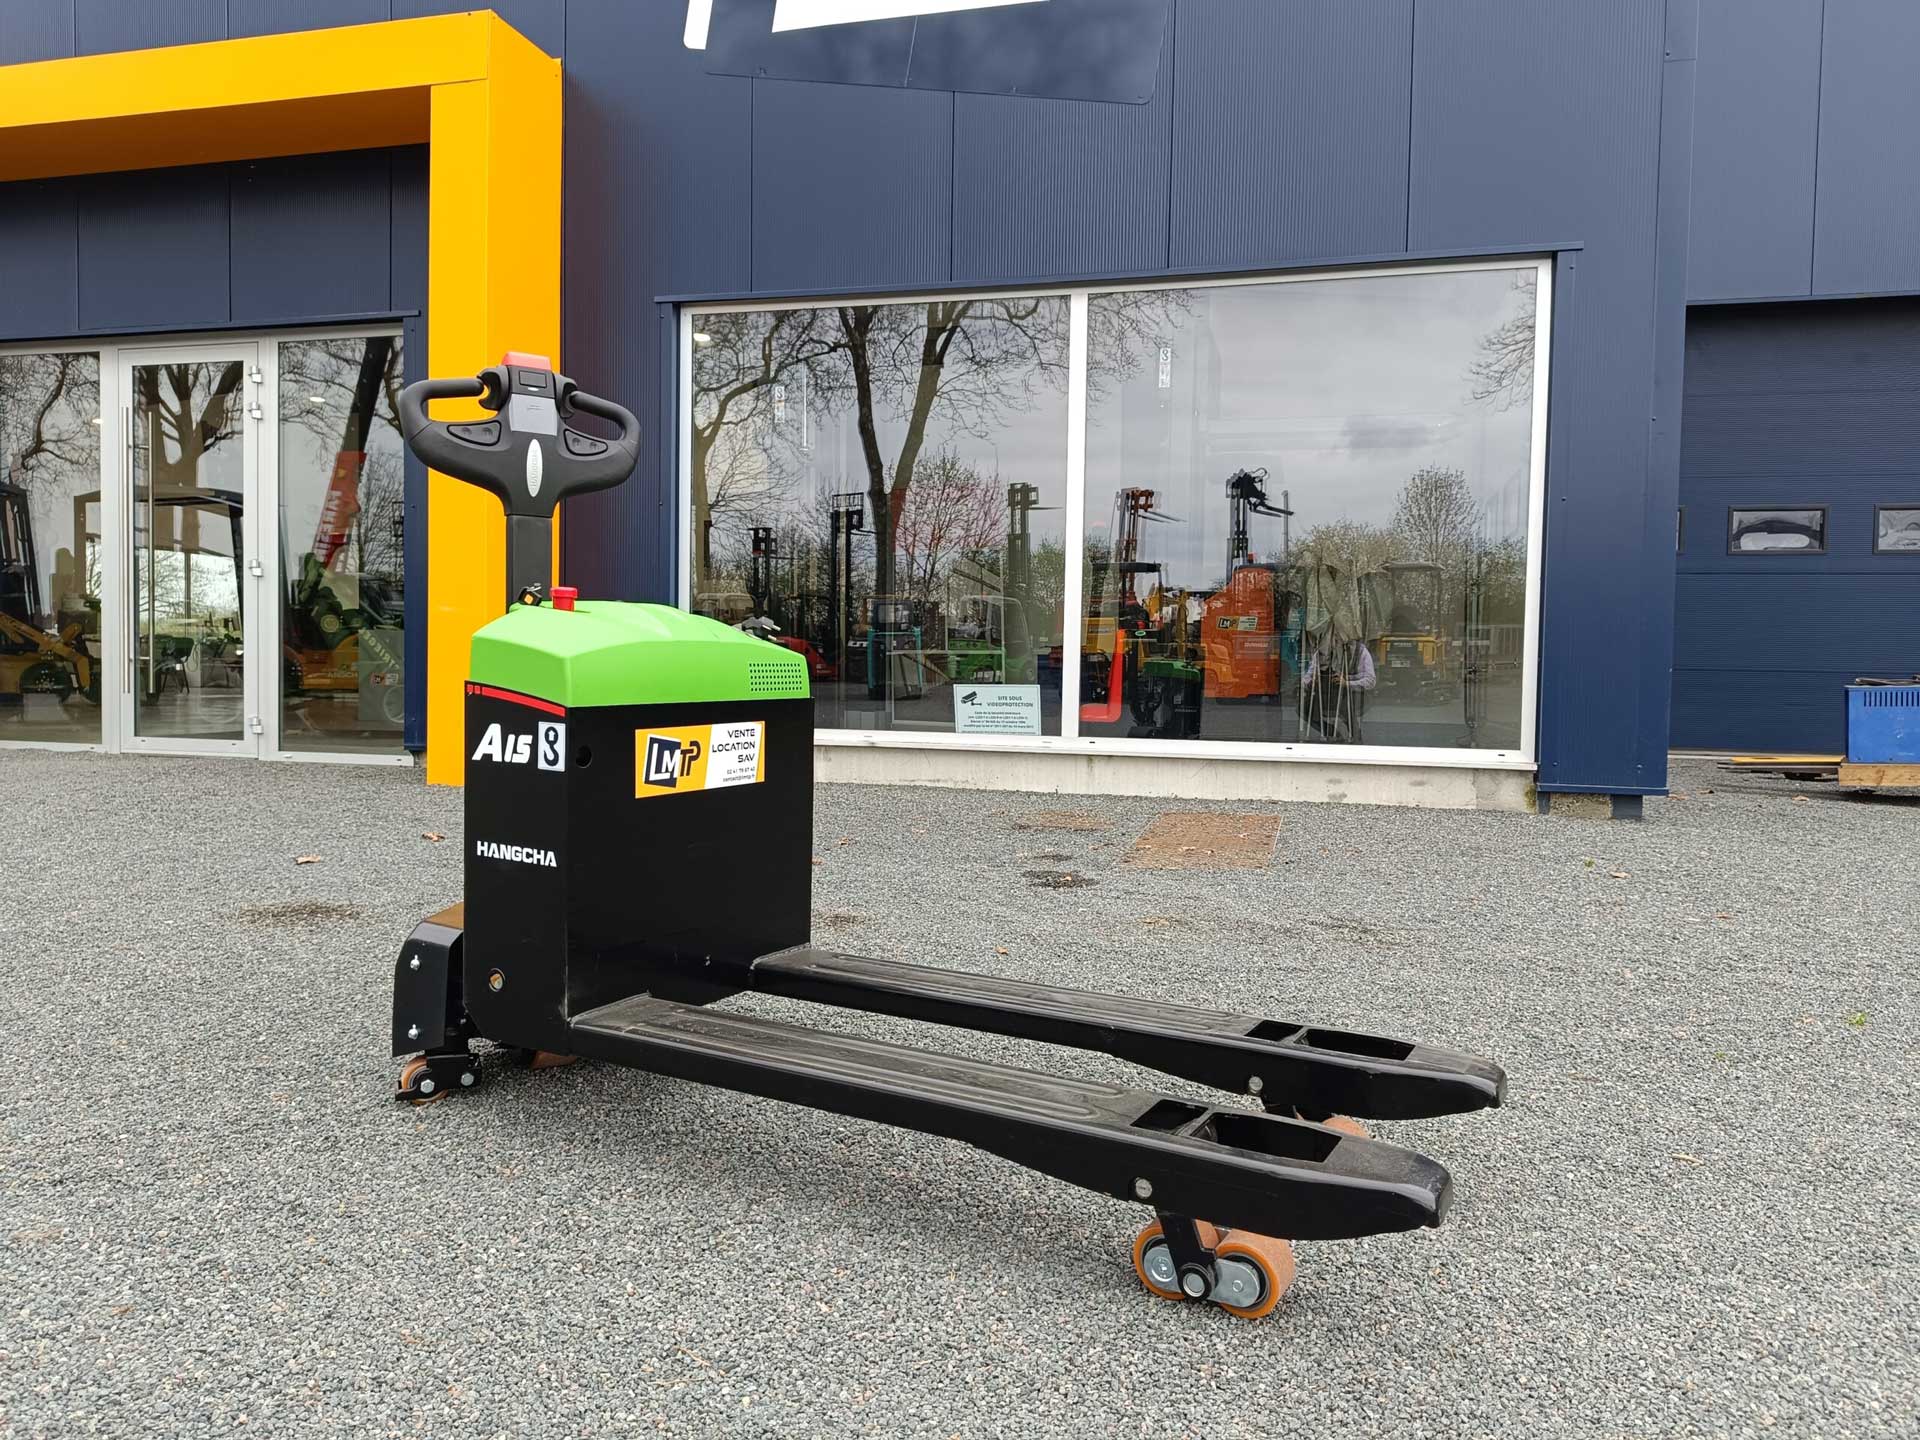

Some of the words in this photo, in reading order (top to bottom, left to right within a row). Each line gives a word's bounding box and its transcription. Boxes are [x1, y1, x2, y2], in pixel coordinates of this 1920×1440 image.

[728, 728, 755, 738] VENTE
[712, 741, 755, 753] LOCATION
[649, 740, 701, 781] LMTP
[738, 753, 755, 763] SAV
[477, 840, 557, 867] HANGCHA
